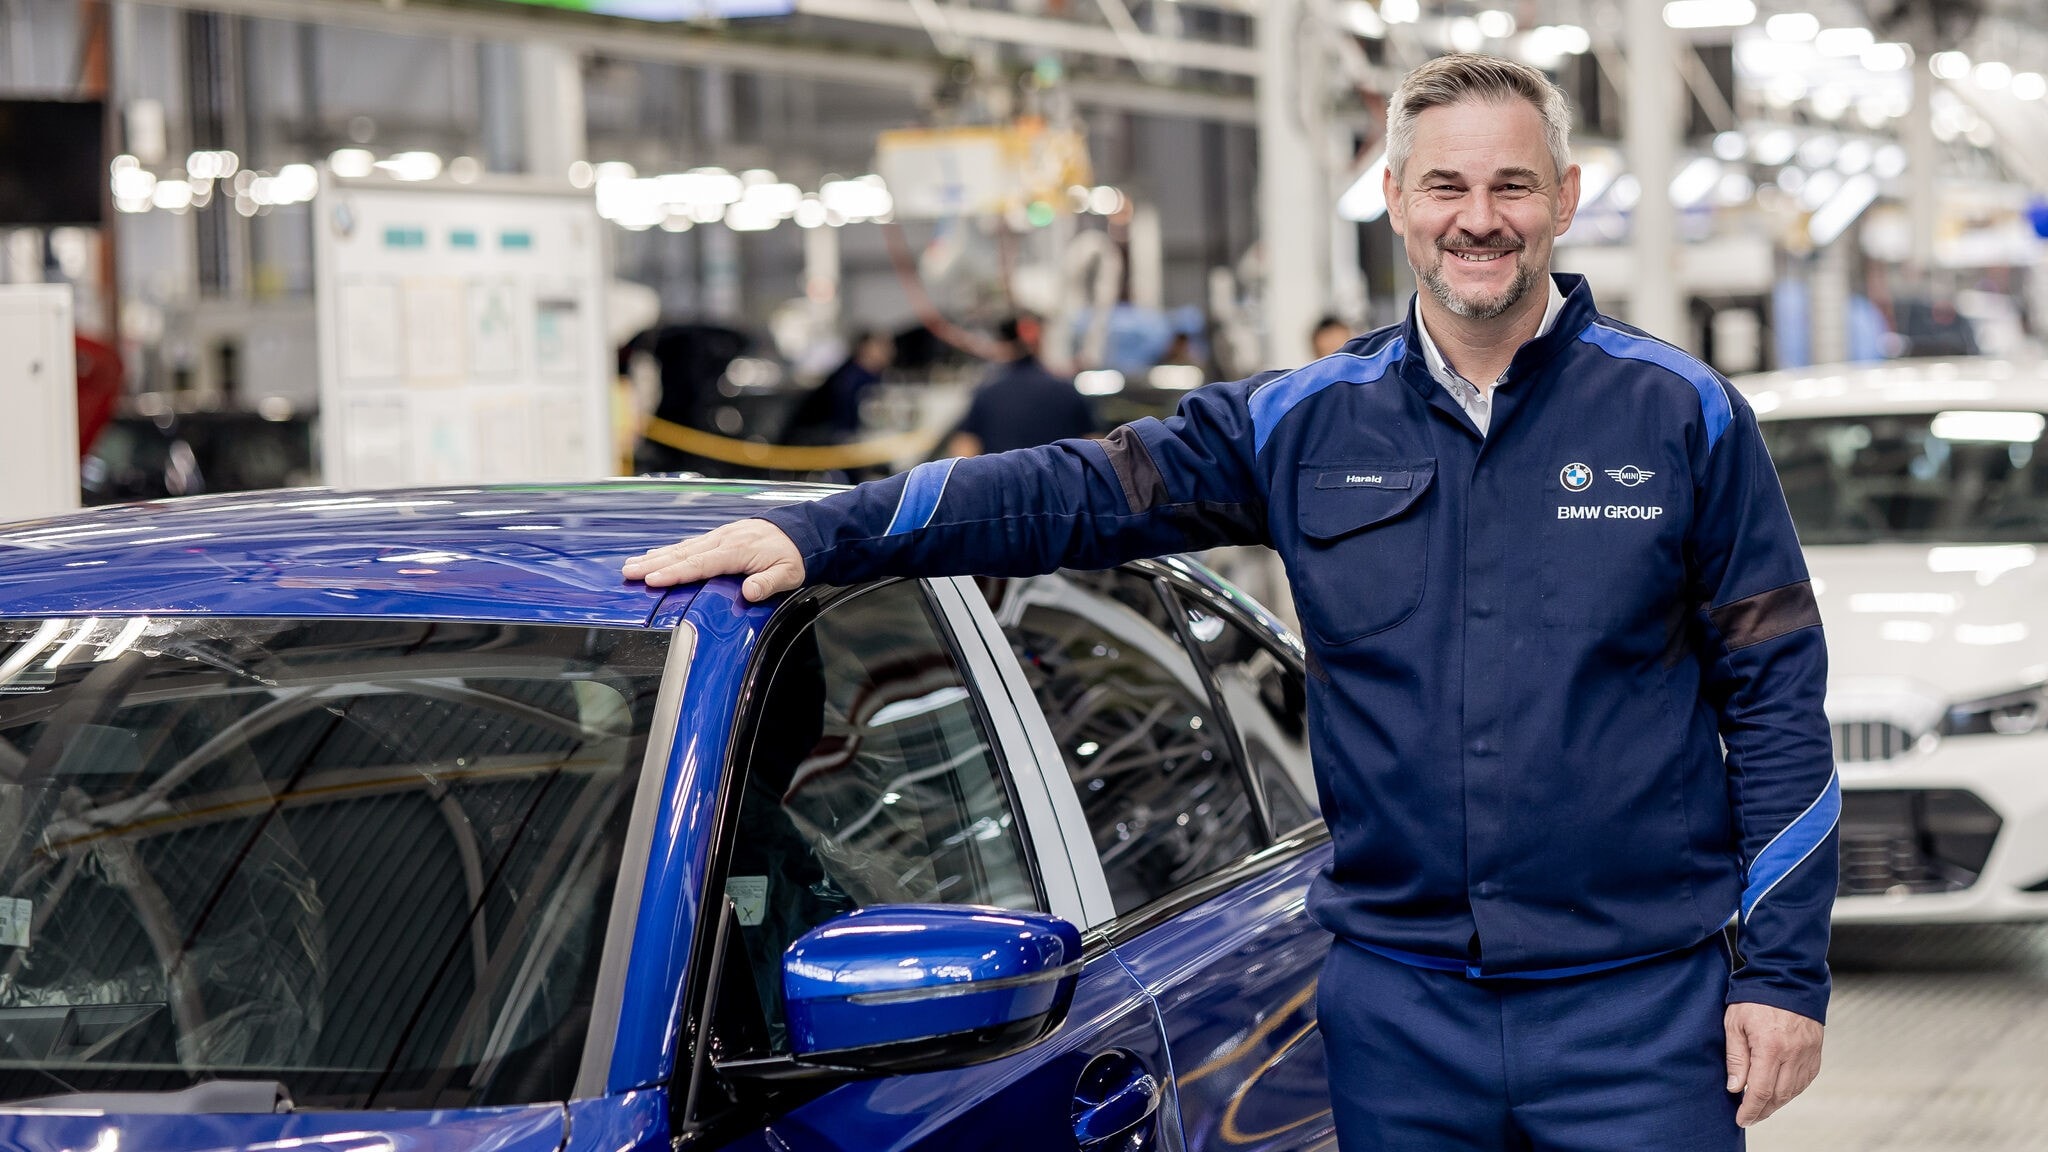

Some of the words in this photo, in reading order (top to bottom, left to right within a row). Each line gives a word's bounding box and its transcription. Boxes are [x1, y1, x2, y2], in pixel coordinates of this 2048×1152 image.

[1346, 475, 1382, 484] Harald
[1621, 472, 1639, 480] MINI
[1557, 505, 1601, 520] BMW
[1604, 505, 1663, 520] GROUP
